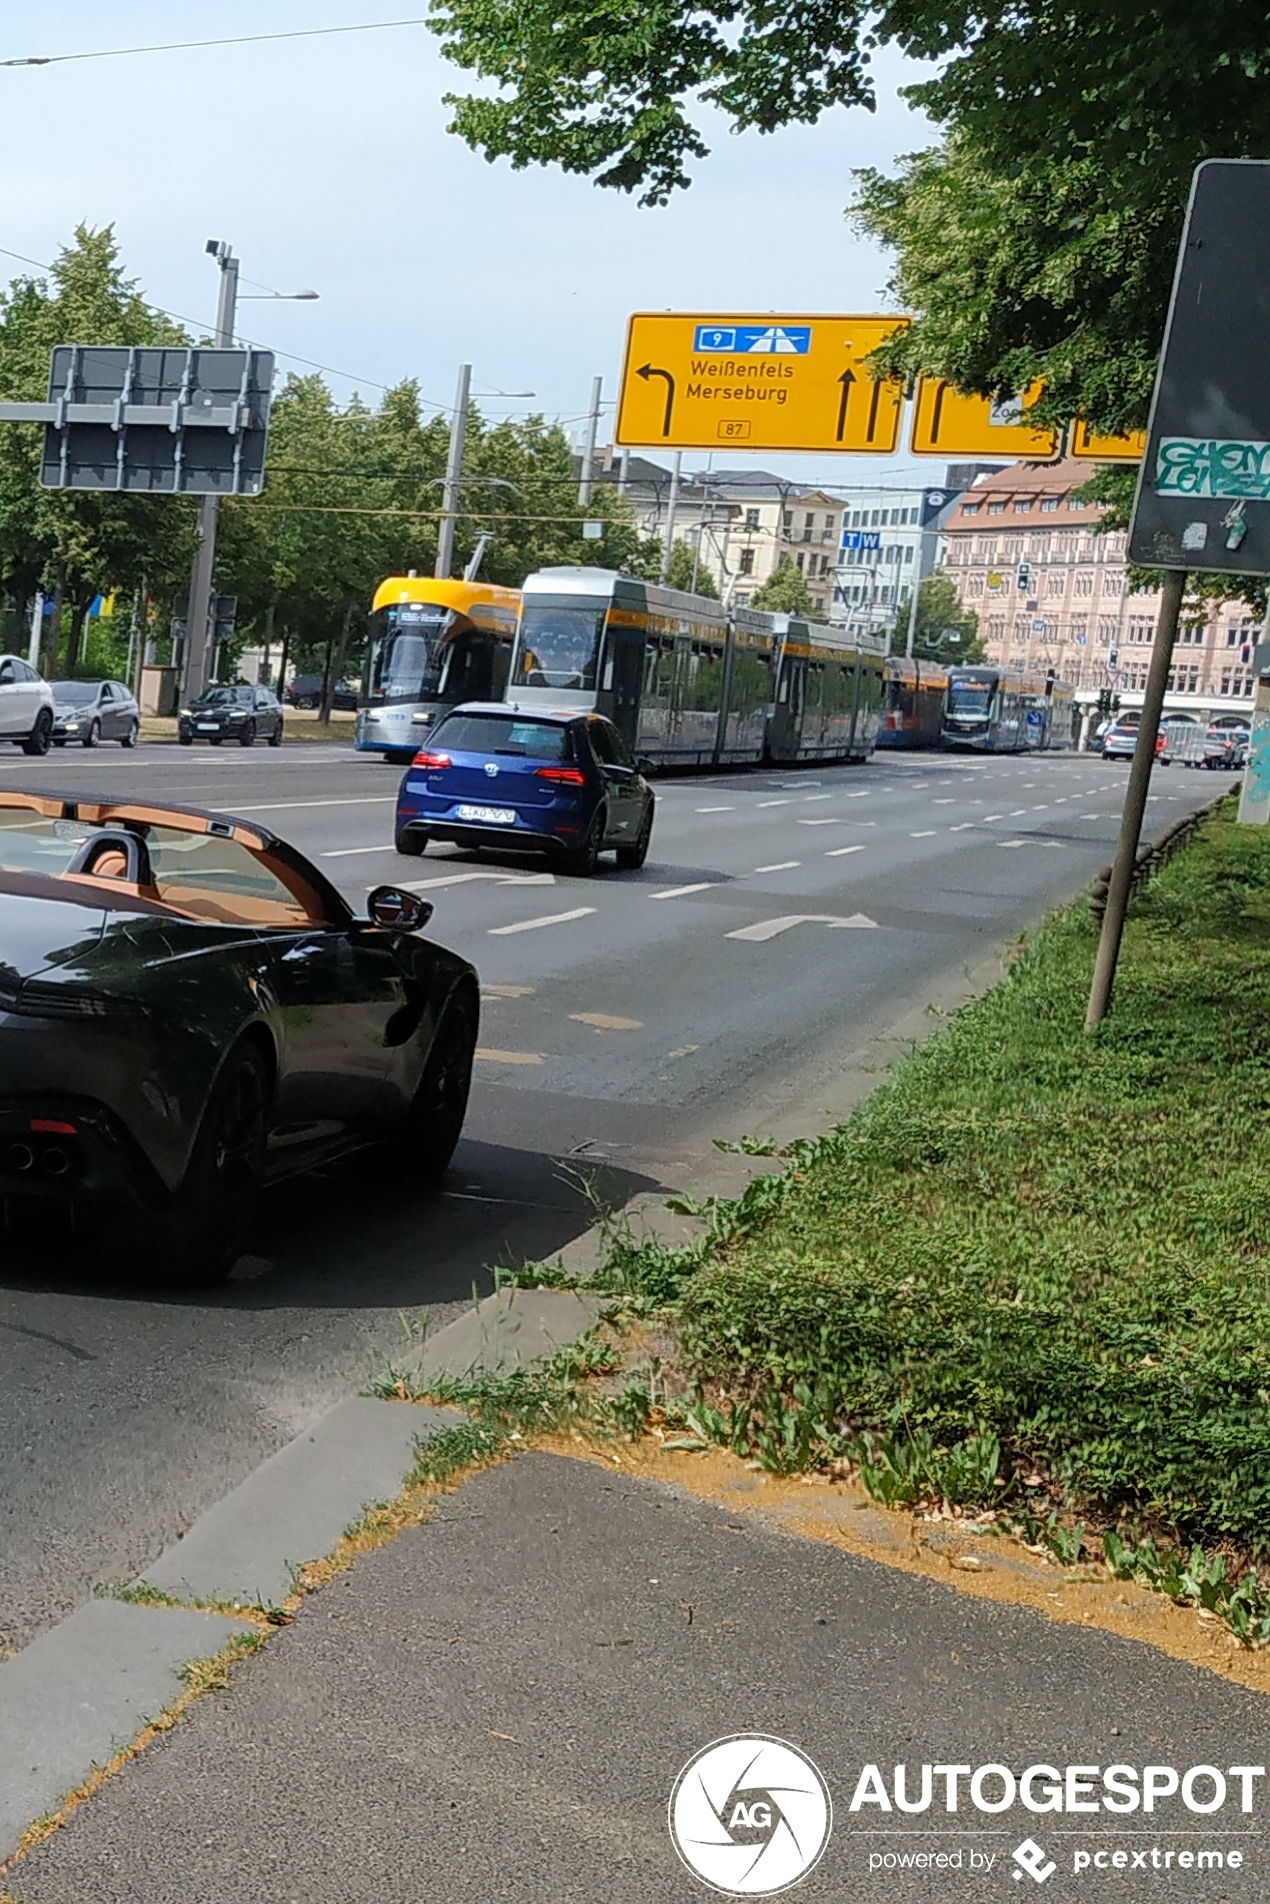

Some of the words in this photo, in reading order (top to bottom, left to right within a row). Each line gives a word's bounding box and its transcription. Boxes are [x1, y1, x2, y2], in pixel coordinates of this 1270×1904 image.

[712, 332, 723, 346] 9
[690, 360, 794, 378] Weißenfels
[685, 383, 788, 405] Merseburg
[725, 423, 744, 436] 87
[846, 533, 858, 547] T
[862, 534, 878, 548] W
